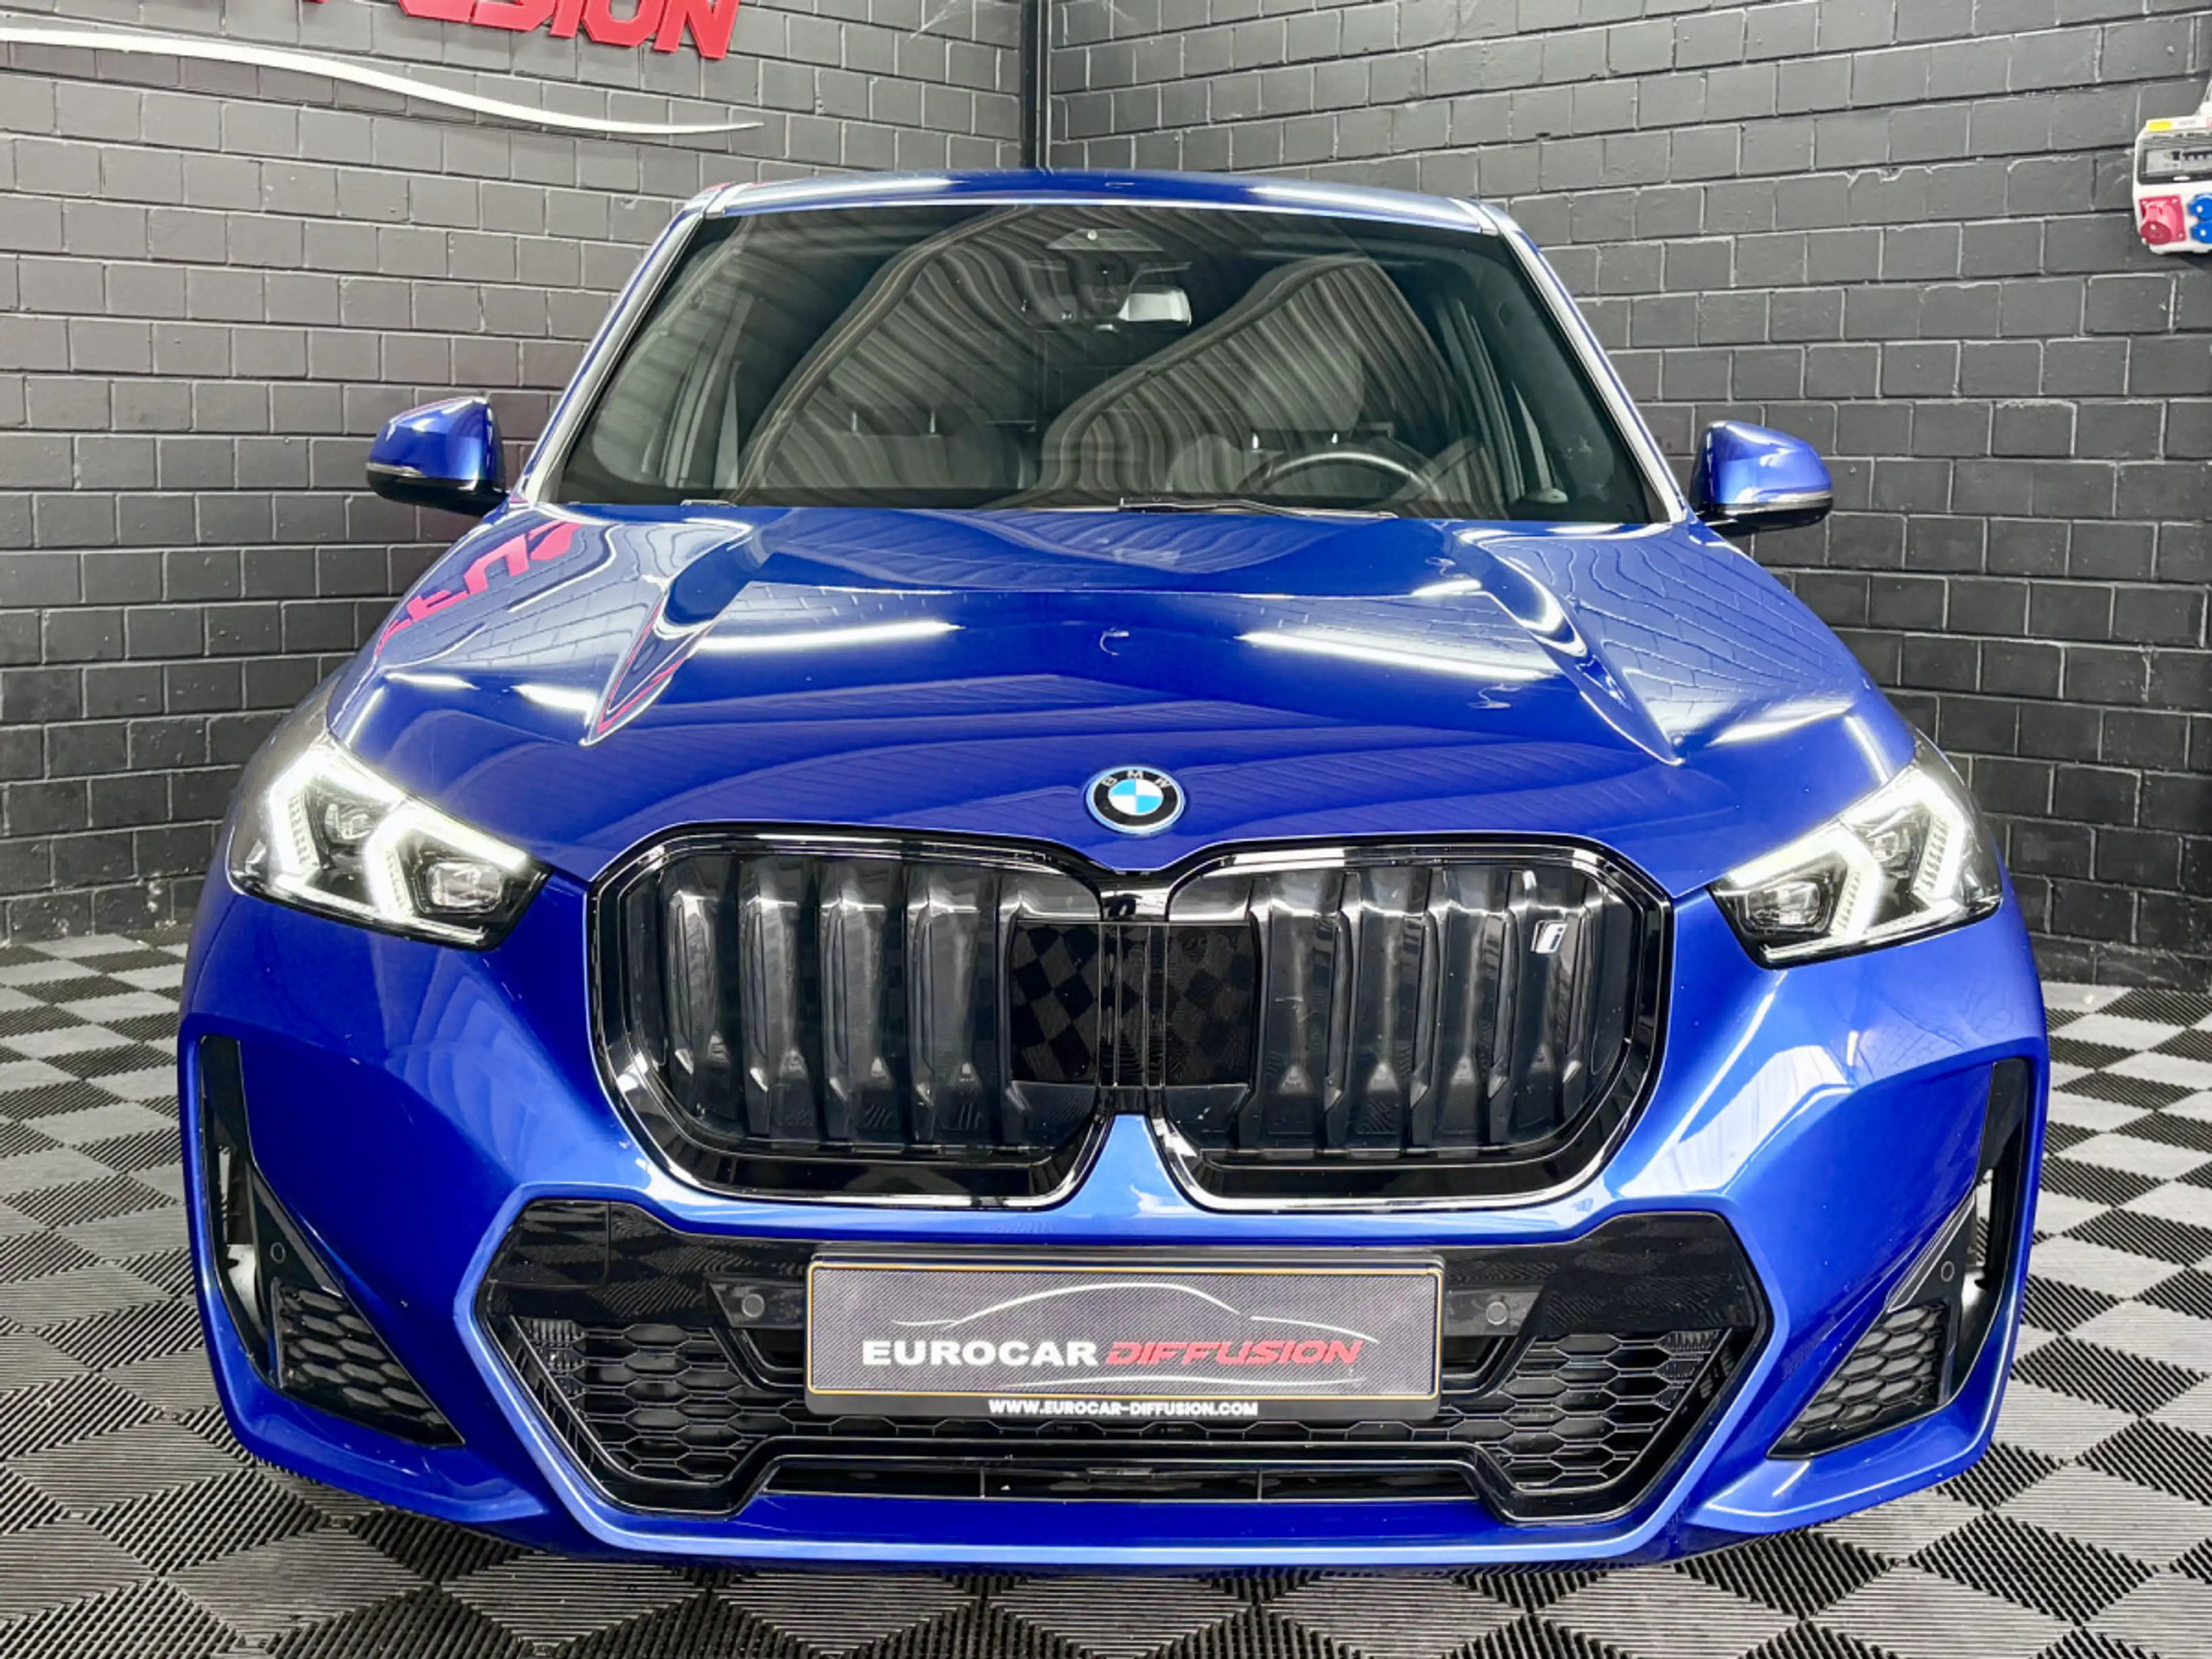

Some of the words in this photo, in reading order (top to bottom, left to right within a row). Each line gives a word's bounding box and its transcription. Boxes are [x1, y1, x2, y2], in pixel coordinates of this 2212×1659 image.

[1100, 770, 1172, 788] BMW
[862, 1340, 1099, 1366] EUROCAR
[1105, 1340, 1363, 1365] DIFFUSION
[988, 1399, 1258, 1416] WWW.EUROCAR-DIFFUSION.COM
